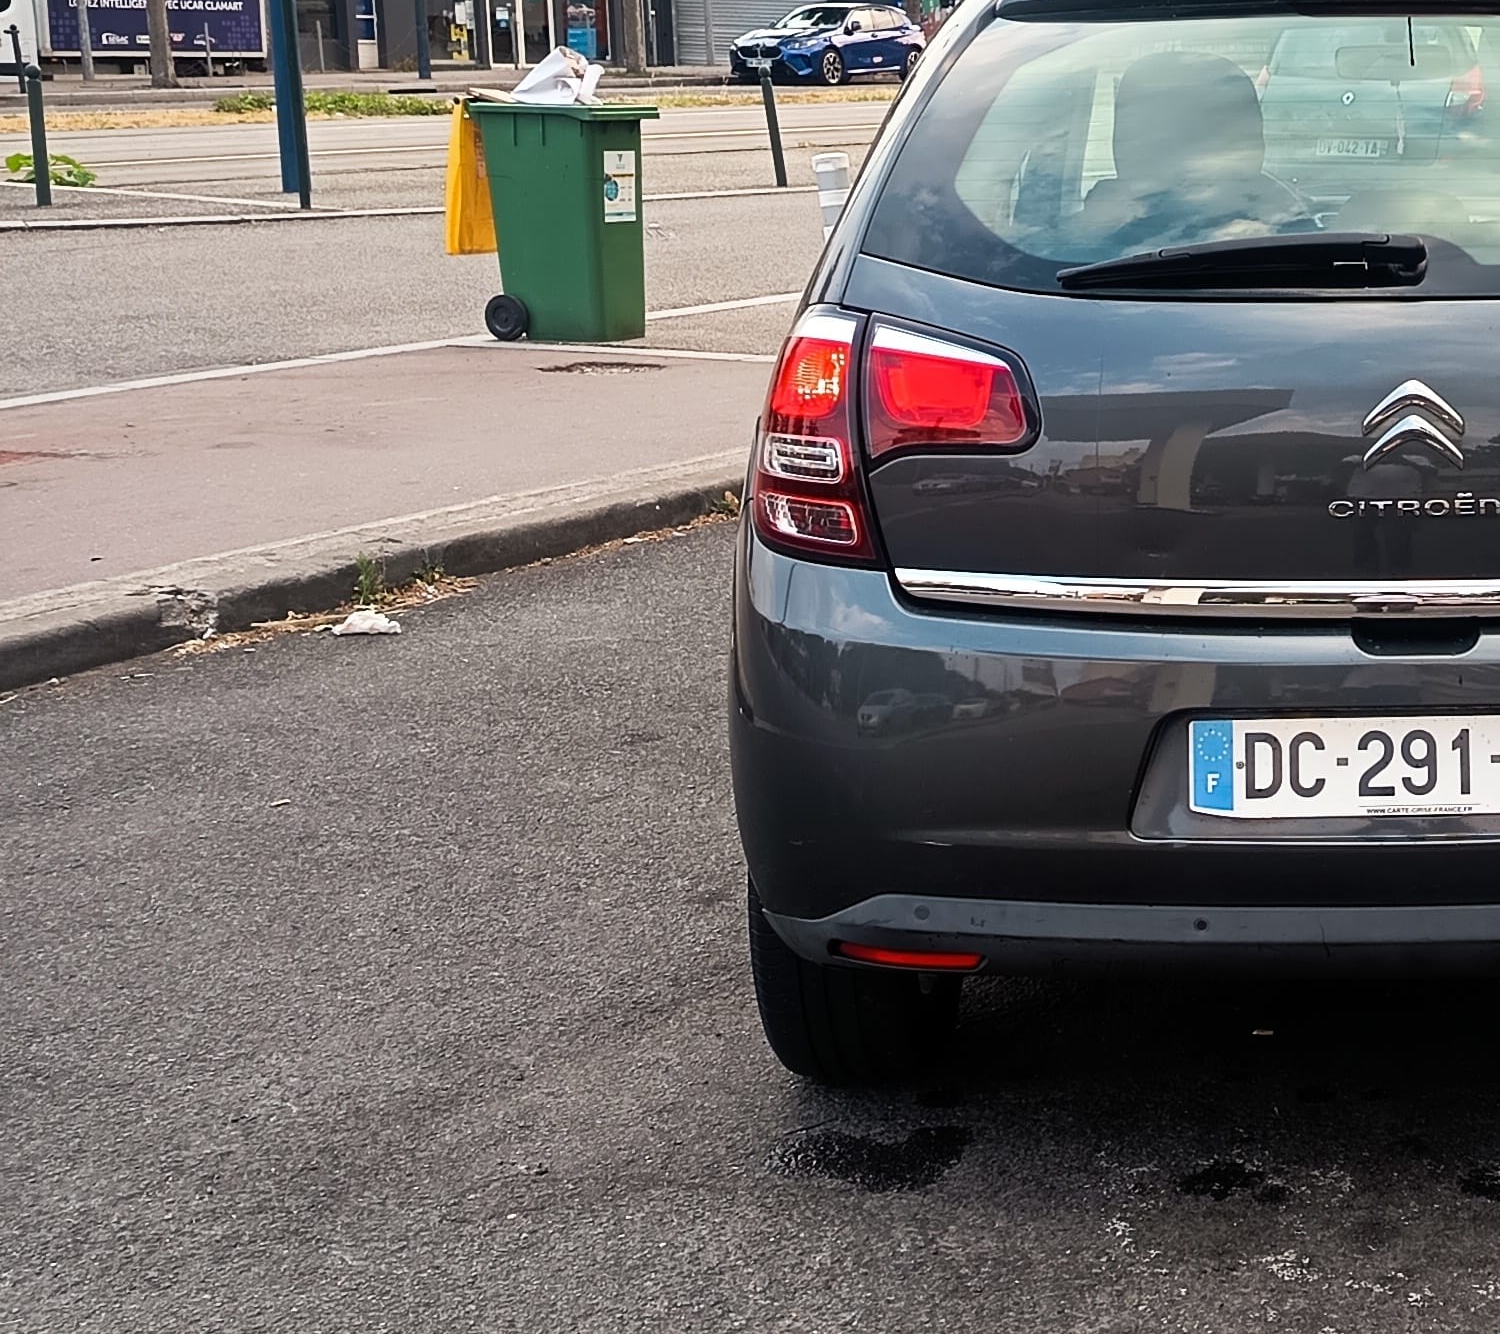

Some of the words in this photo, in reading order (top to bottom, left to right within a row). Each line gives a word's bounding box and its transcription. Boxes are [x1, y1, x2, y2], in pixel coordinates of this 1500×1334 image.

[180, 0, 204, 10] UCAR
[205, 0, 243, 11] CLAMART
[1207, 773, 1220, 793] F
